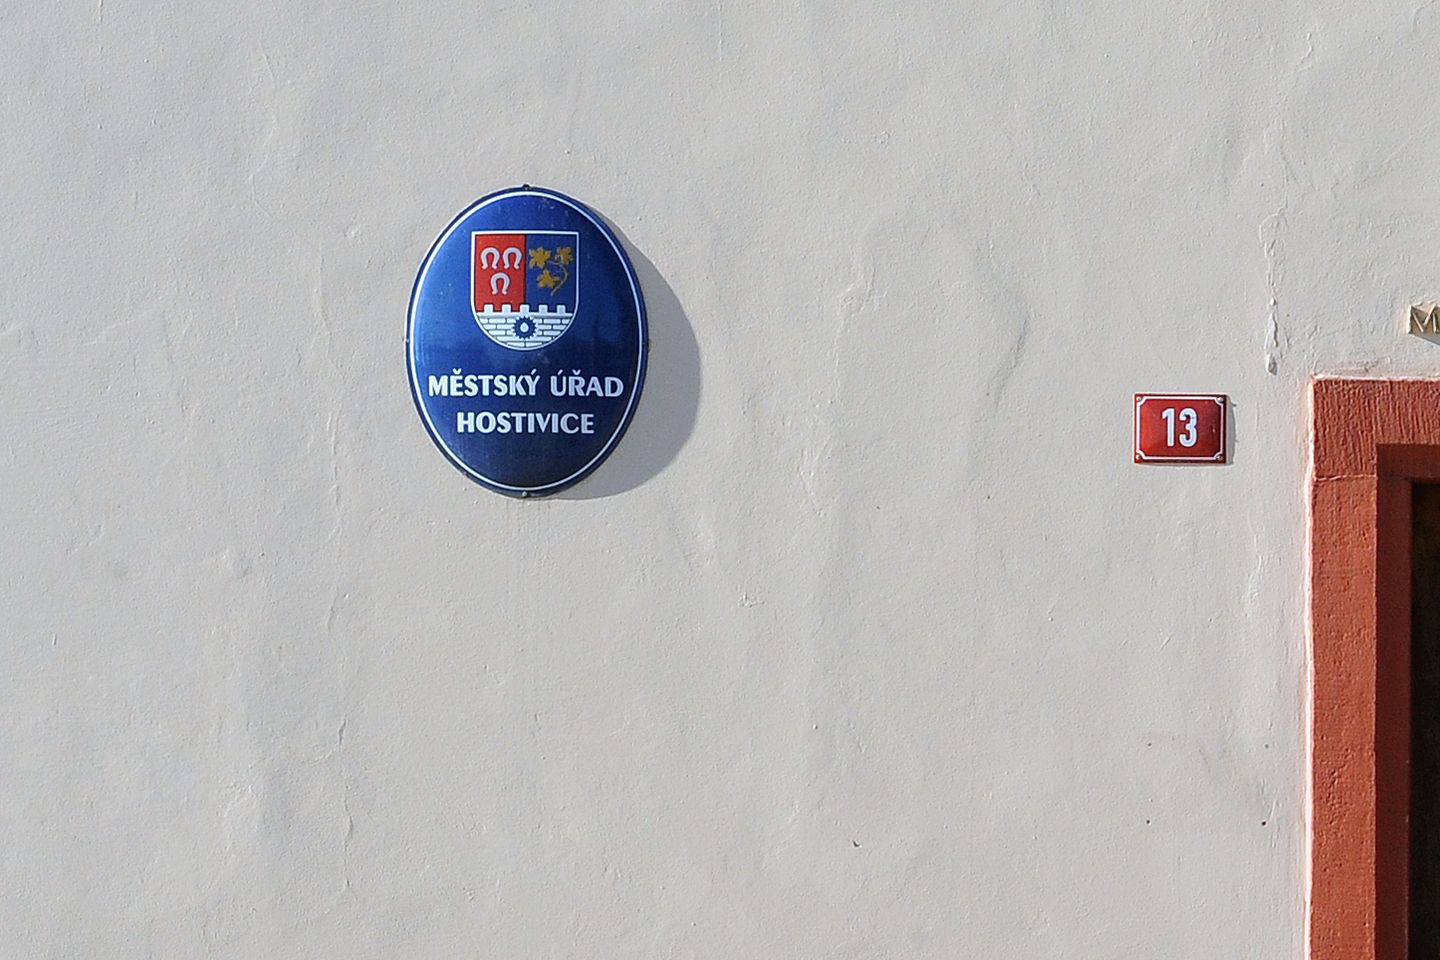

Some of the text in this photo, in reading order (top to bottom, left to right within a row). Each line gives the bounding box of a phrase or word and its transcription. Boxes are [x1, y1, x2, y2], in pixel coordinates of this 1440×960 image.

[429, 368, 624, 397] MĚSTSKÝ ÚŘAD
[456, 412, 595, 434] HOSTIVICE
[1161, 407, 1197, 447] 13
